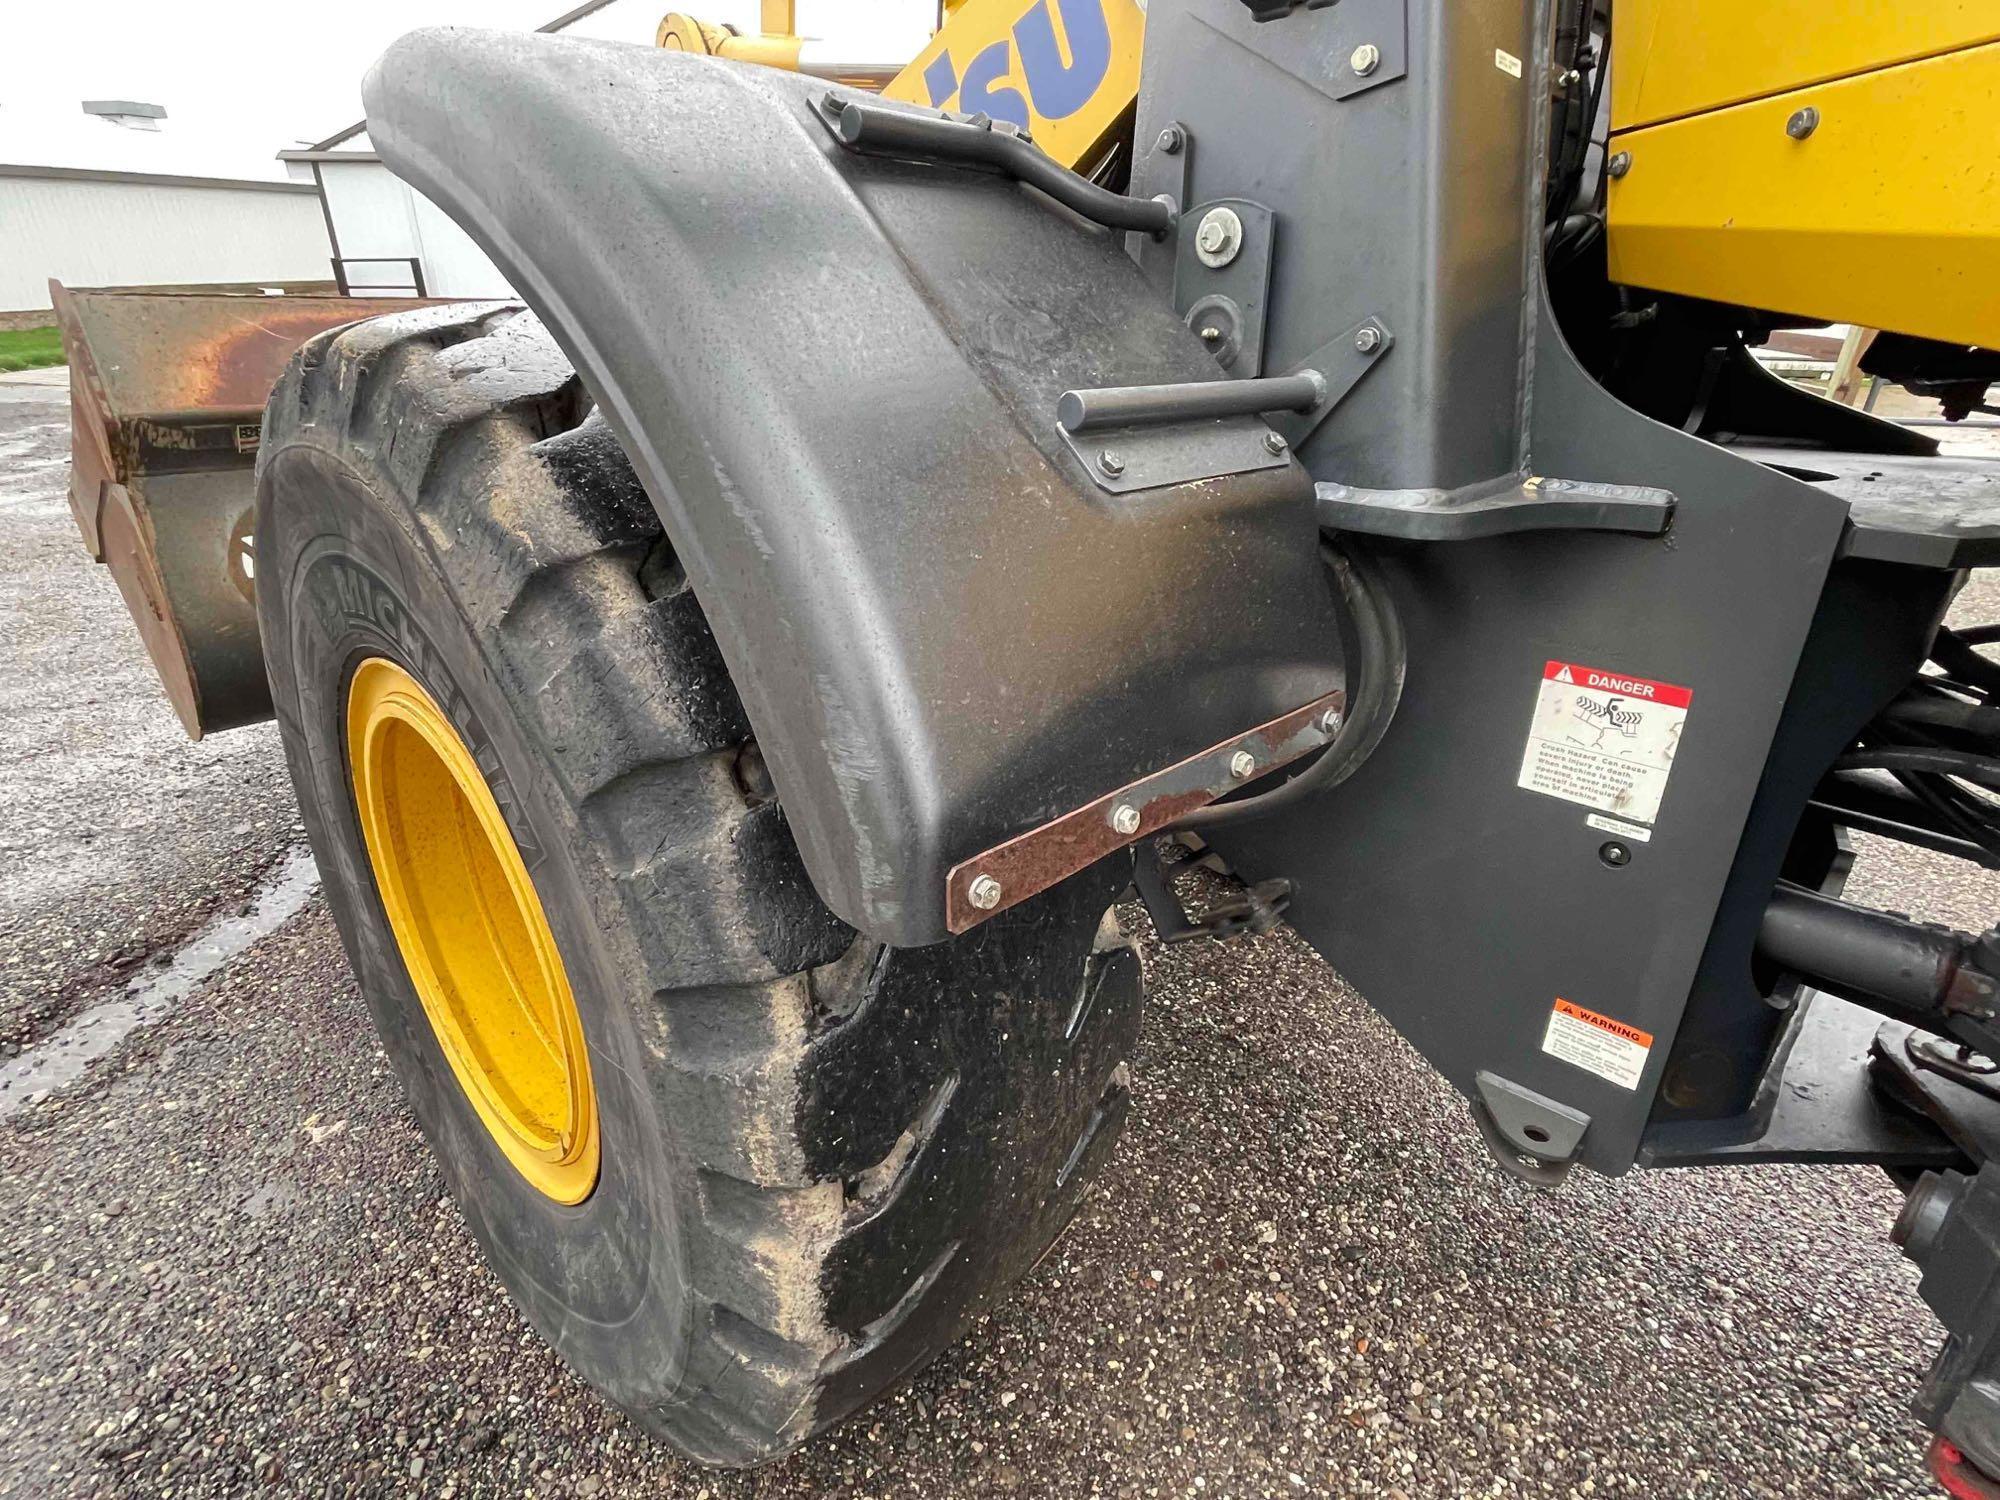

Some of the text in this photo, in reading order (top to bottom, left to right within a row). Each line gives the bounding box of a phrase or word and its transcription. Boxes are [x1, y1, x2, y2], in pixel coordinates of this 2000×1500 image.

[1588, 673, 1654, 698] DANGER
[332, 564, 537, 850] MICHELIN
[1567, 757, 1592, 769] injury
[1601, 758, 1618, 767] Can
[1620, 763, 1647, 774] cause
[1533, 772, 1567, 785] yourself
[1537, 757, 1560, 767] When
[1561, 764, 1596, 777] machine
[1608, 776, 1634, 788] being
[1576, 776, 1599, 785] never
[1532, 780, 1549, 788] area
[1579, 1010, 1640, 1041] WARNING
